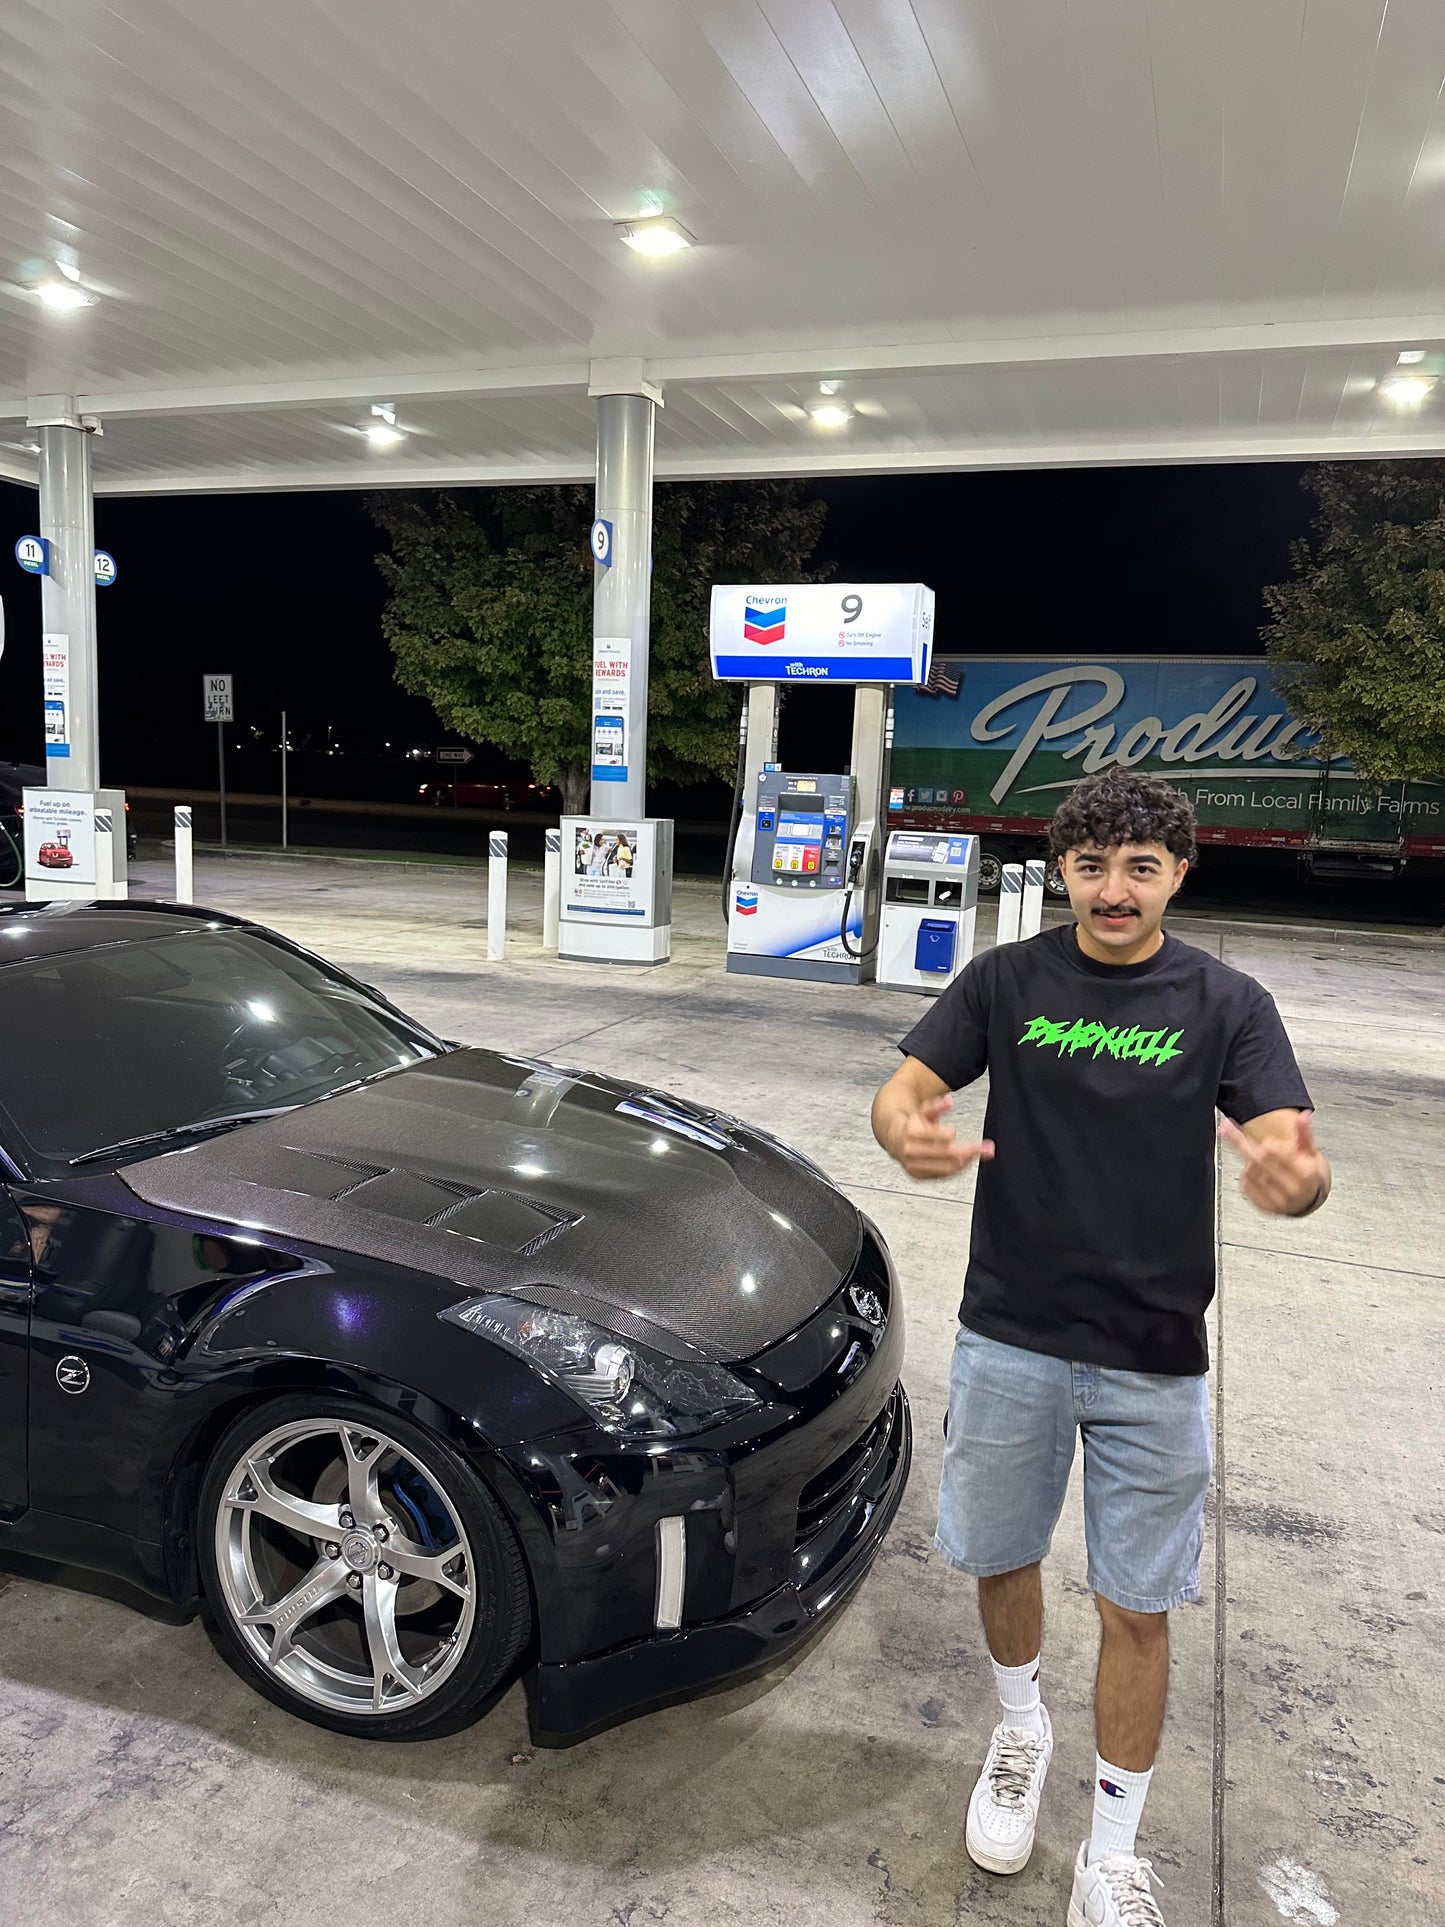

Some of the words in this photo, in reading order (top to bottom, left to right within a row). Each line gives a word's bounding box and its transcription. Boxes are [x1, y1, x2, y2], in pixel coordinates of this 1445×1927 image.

[597, 531, 605, 550] 9
[25, 543, 35, 558] 11
[97, 558, 110, 572] 12
[745, 595, 788, 605] Chevron
[841, 594, 863, 624] 9
[50, 653, 66, 661] WITH
[609, 661, 628, 669] WITH
[785, 665, 829, 678] TECHRON
[595, 669, 626, 677] REWARDS
[210, 679, 226, 692] NO
[1195, 788, 1245, 807] From
[1250, 790, 1303, 809] Local
[1308, 793, 1370, 815] Family
[1377, 796, 1440, 815] Farms
[736, 889, 759, 897] Chevron
[823, 949, 857, 960] TECHRON
